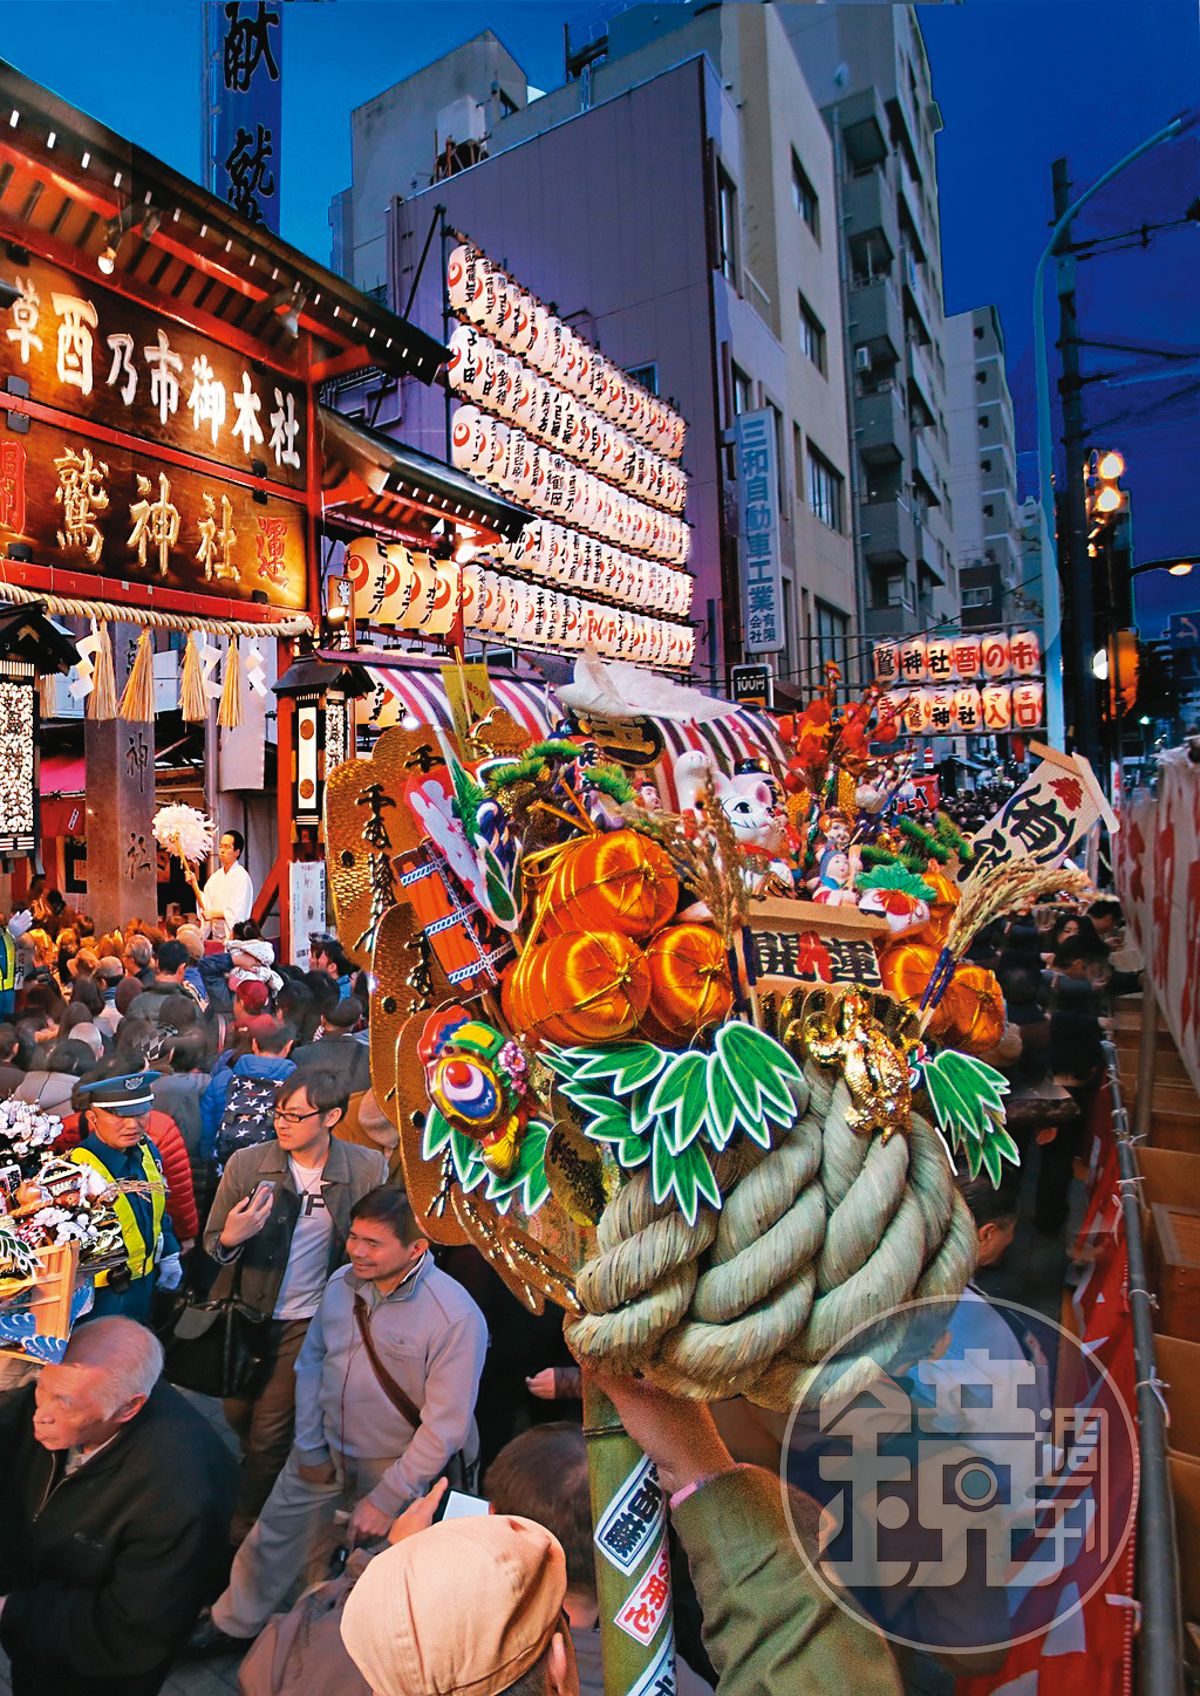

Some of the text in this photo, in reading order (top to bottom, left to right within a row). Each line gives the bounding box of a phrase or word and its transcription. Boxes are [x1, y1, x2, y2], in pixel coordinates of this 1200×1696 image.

[53, 446, 241, 583] 鷲神社
[741, 419, 774, 612] 三和自動車工業
[737, 675, 766, 692] 100円
[751, 929, 883, 989] 開運
